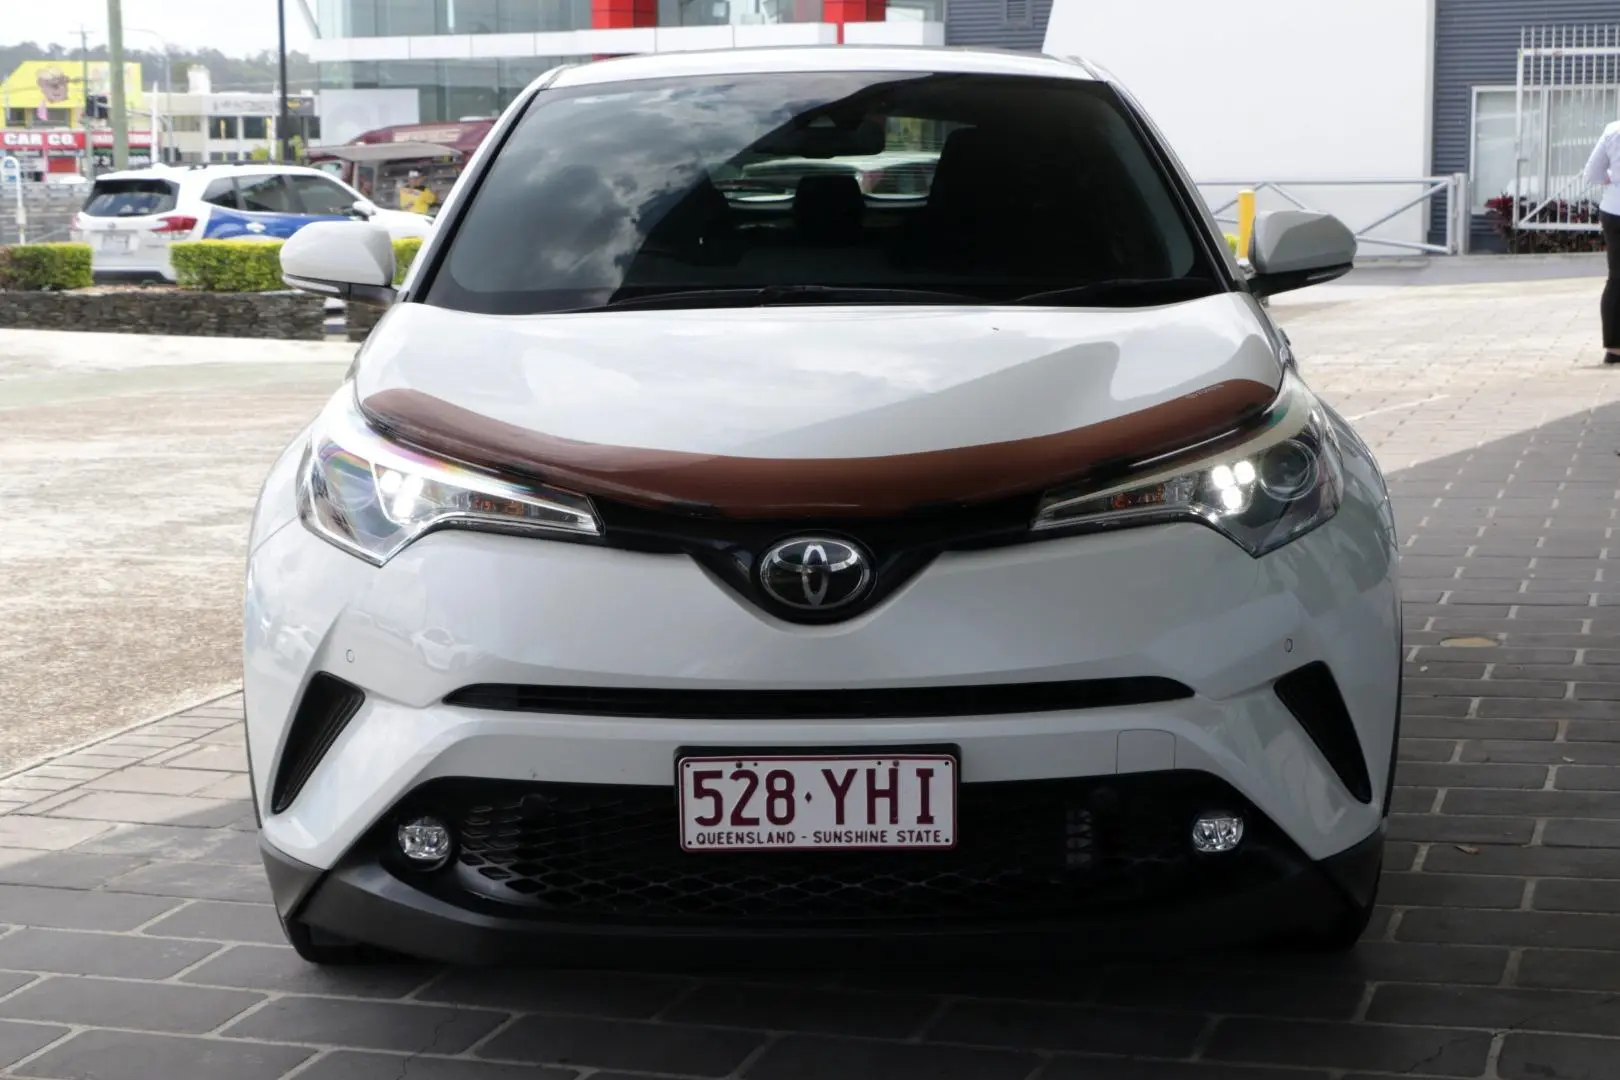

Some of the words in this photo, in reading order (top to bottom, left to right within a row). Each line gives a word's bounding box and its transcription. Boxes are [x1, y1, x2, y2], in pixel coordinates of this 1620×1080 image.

[4, 132, 42, 145] CAR
[696, 831, 796, 845] QUEENSLAND
[813, 830, 888, 843] SUNSHINE
[896, 829, 942, 843] STATE
